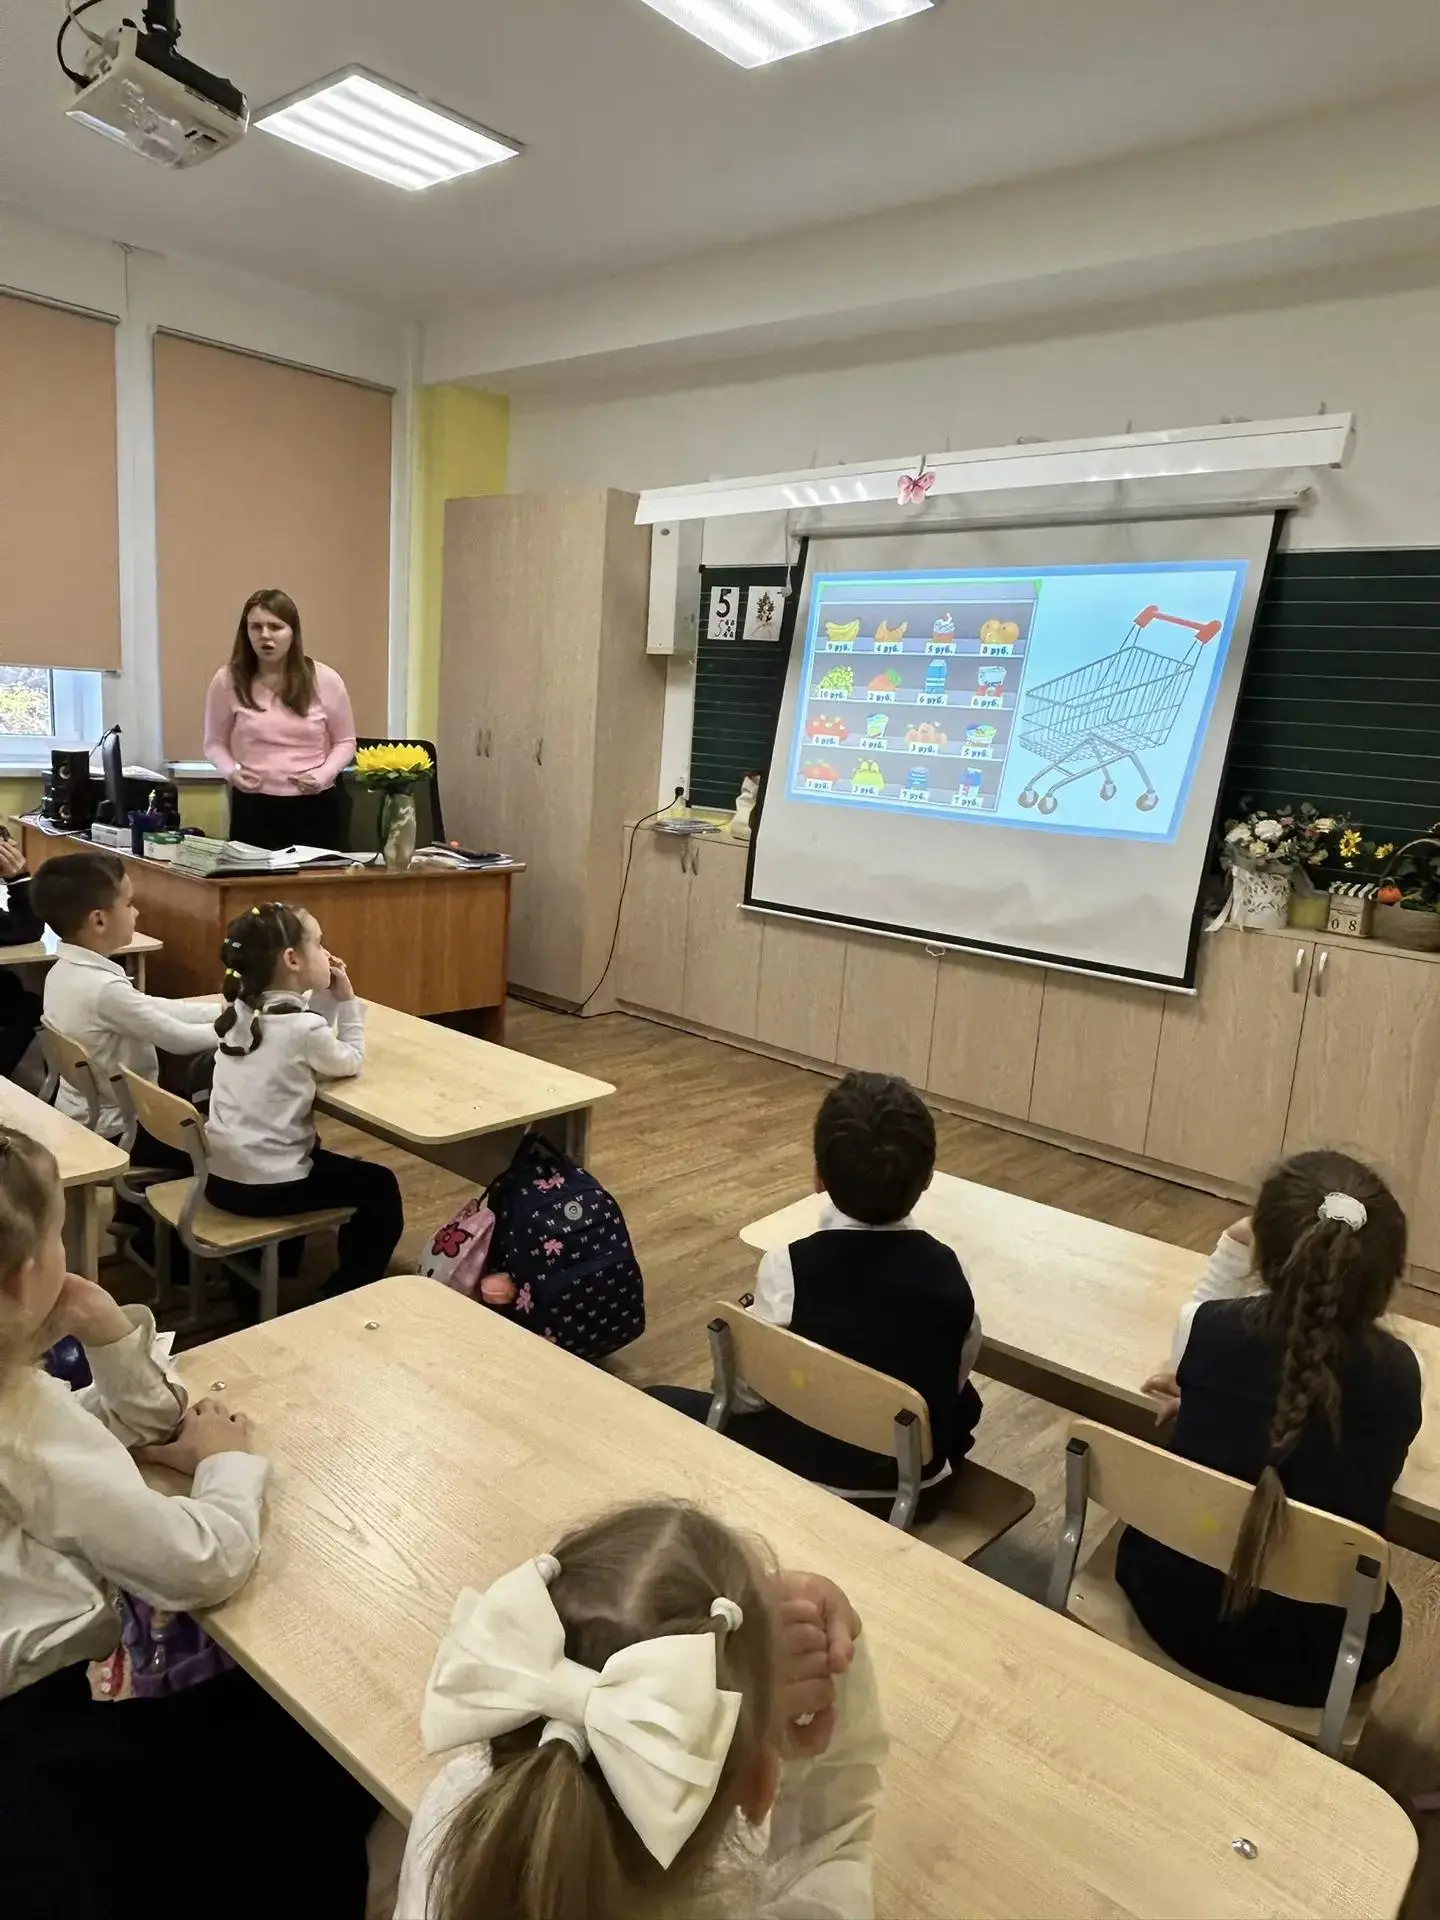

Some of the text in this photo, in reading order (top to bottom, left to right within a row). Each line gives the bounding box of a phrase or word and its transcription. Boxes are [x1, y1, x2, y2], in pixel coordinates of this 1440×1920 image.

[716, 588, 732, 618] 5
[834, 644, 850, 652] руб.
[884, 645, 899, 653] руб.
[935, 645, 953, 654] руб.
[990, 647, 1009, 656] руб.
[830, 691, 845, 699] руб.
[876, 693, 892, 702] руб.
[926, 696, 944, 705] руб.
[981, 699, 1000, 708] руб.
[820, 738, 837, 746] руб.
[868, 741, 885, 750] руб.
[918, 745, 936, 754] руб.
[971, 749, 990, 758] руб.
[814, 782, 829, 790] руб.
[860, 787, 876, 795] руб.
[909, 793, 926, 801] руб.
[961, 797, 980, 806] руб.
